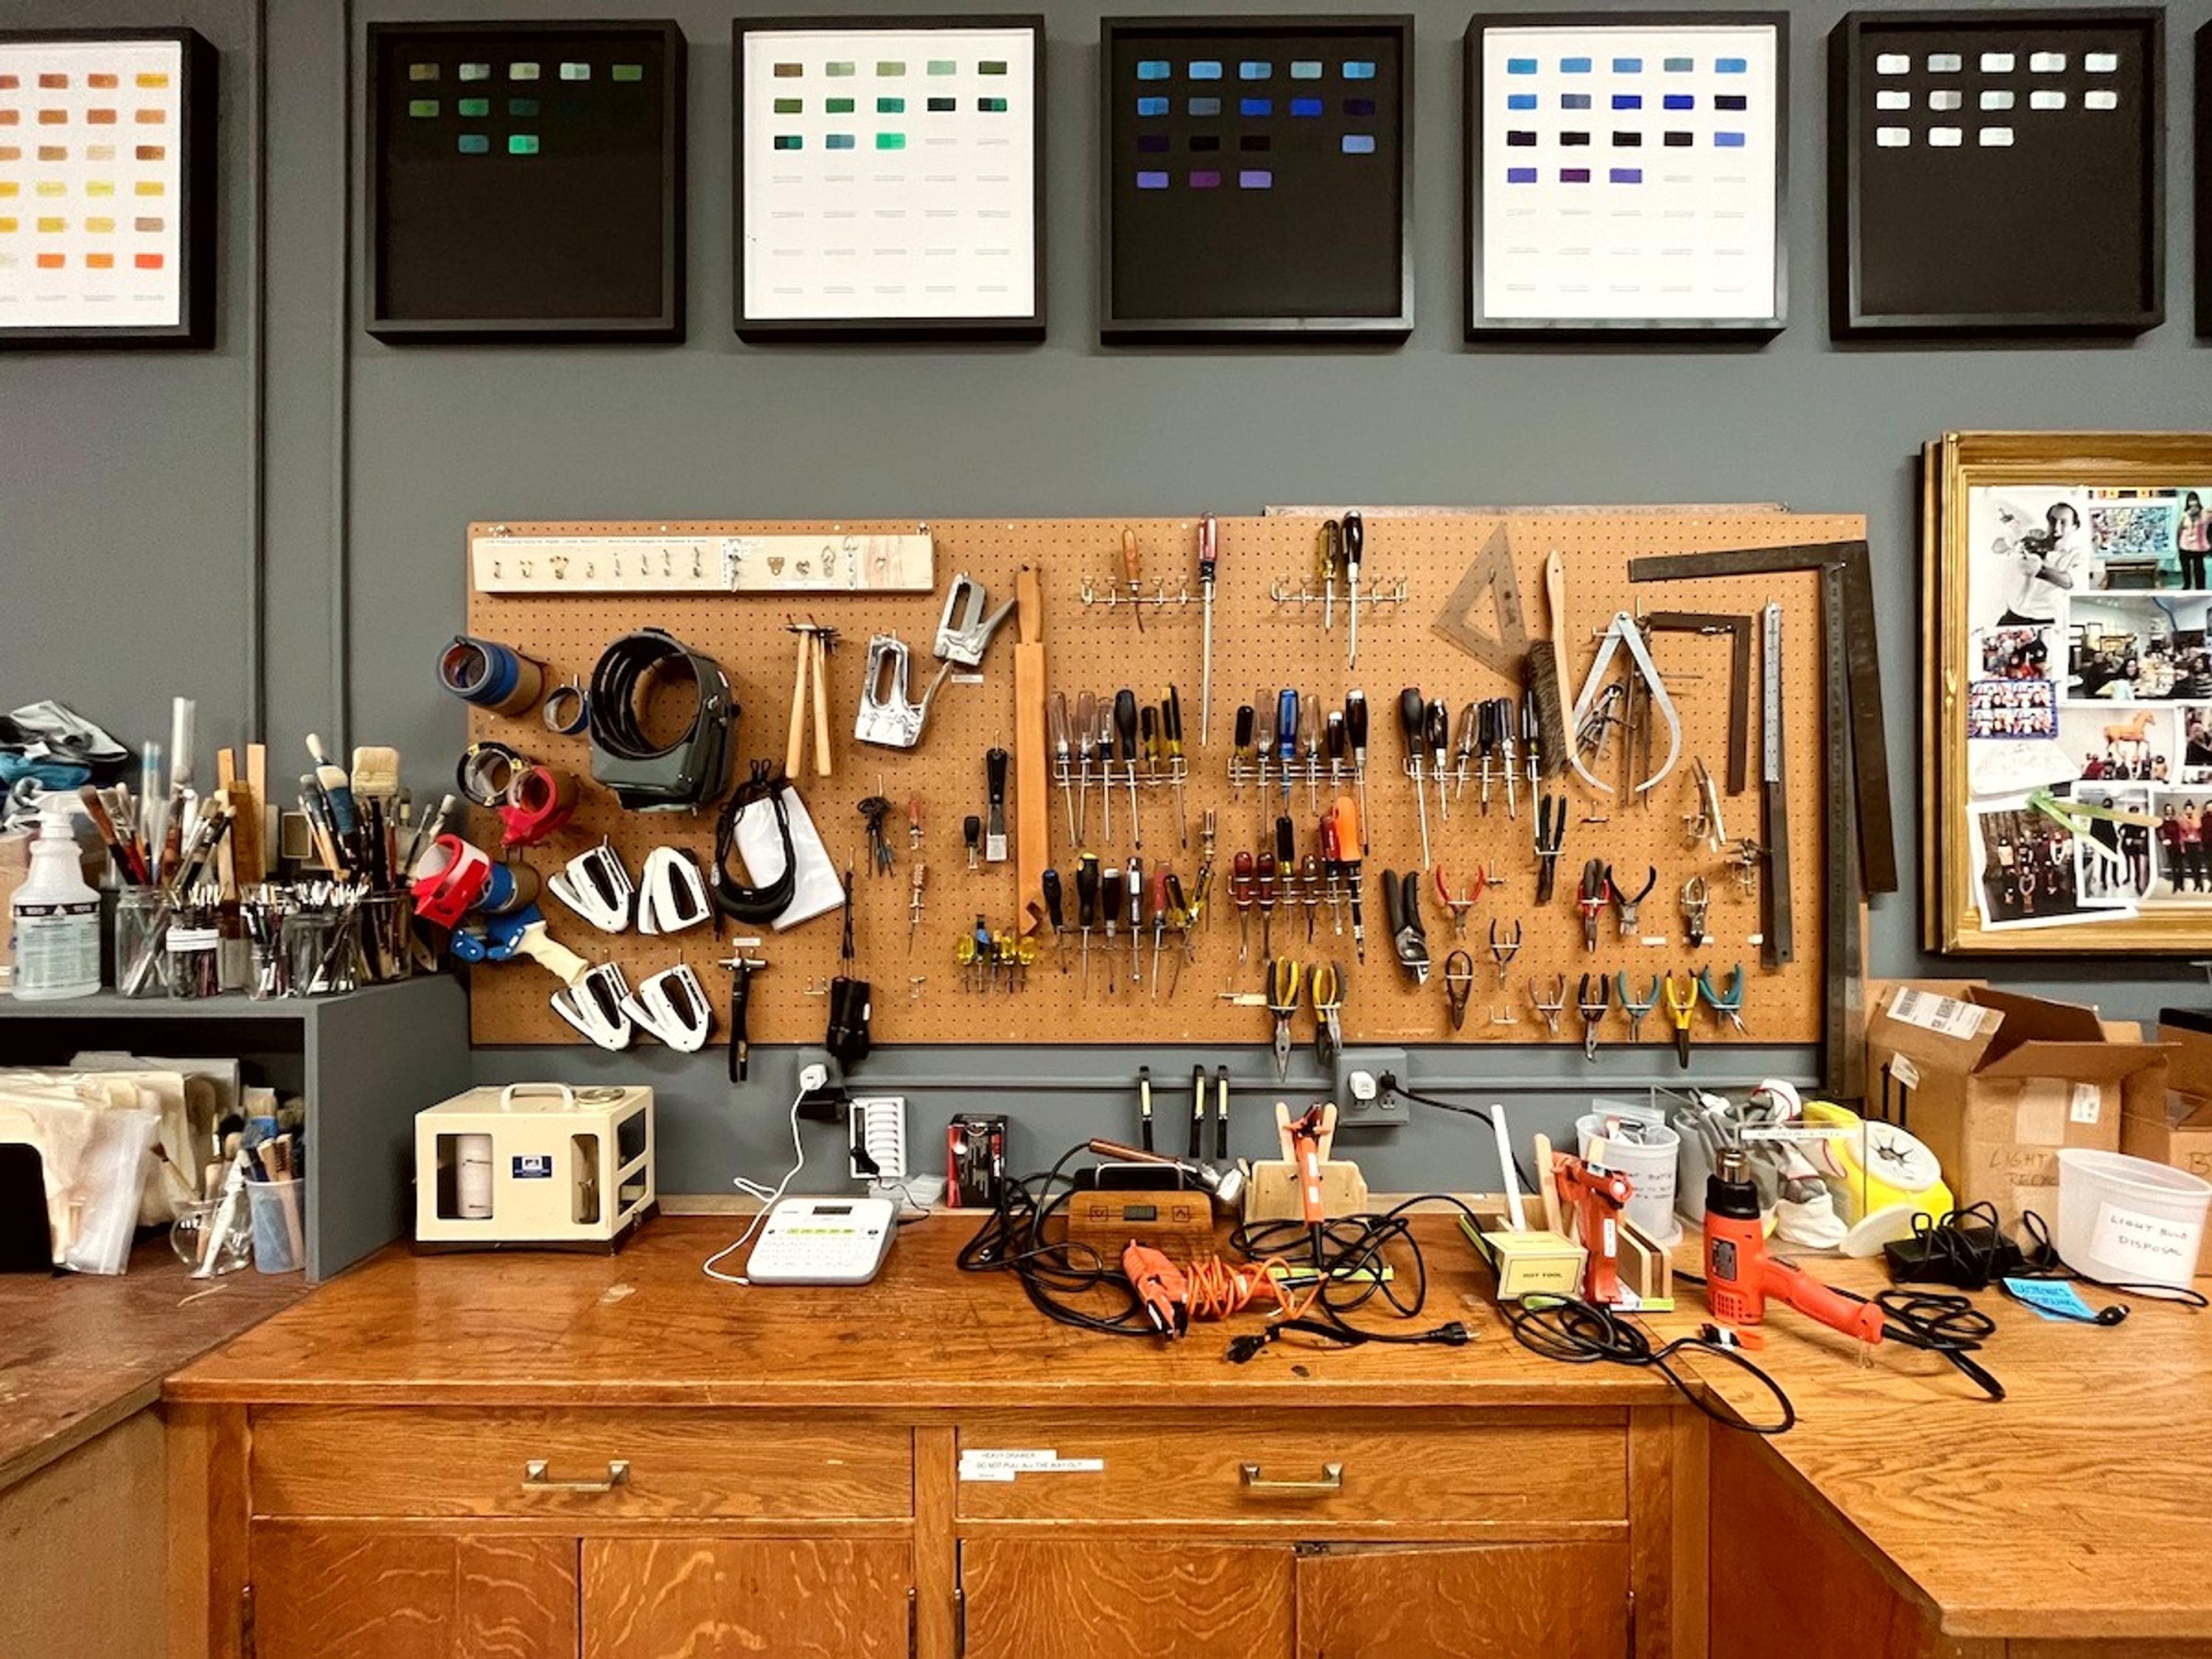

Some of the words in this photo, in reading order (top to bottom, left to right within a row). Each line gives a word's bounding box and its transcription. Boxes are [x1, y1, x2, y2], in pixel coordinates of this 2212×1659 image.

[1989, 1149, 2048, 1168] LIGHT
[2111, 1214, 2153, 1232] LIGHT
[2119, 1235, 2183, 1256] DISPOSAL
